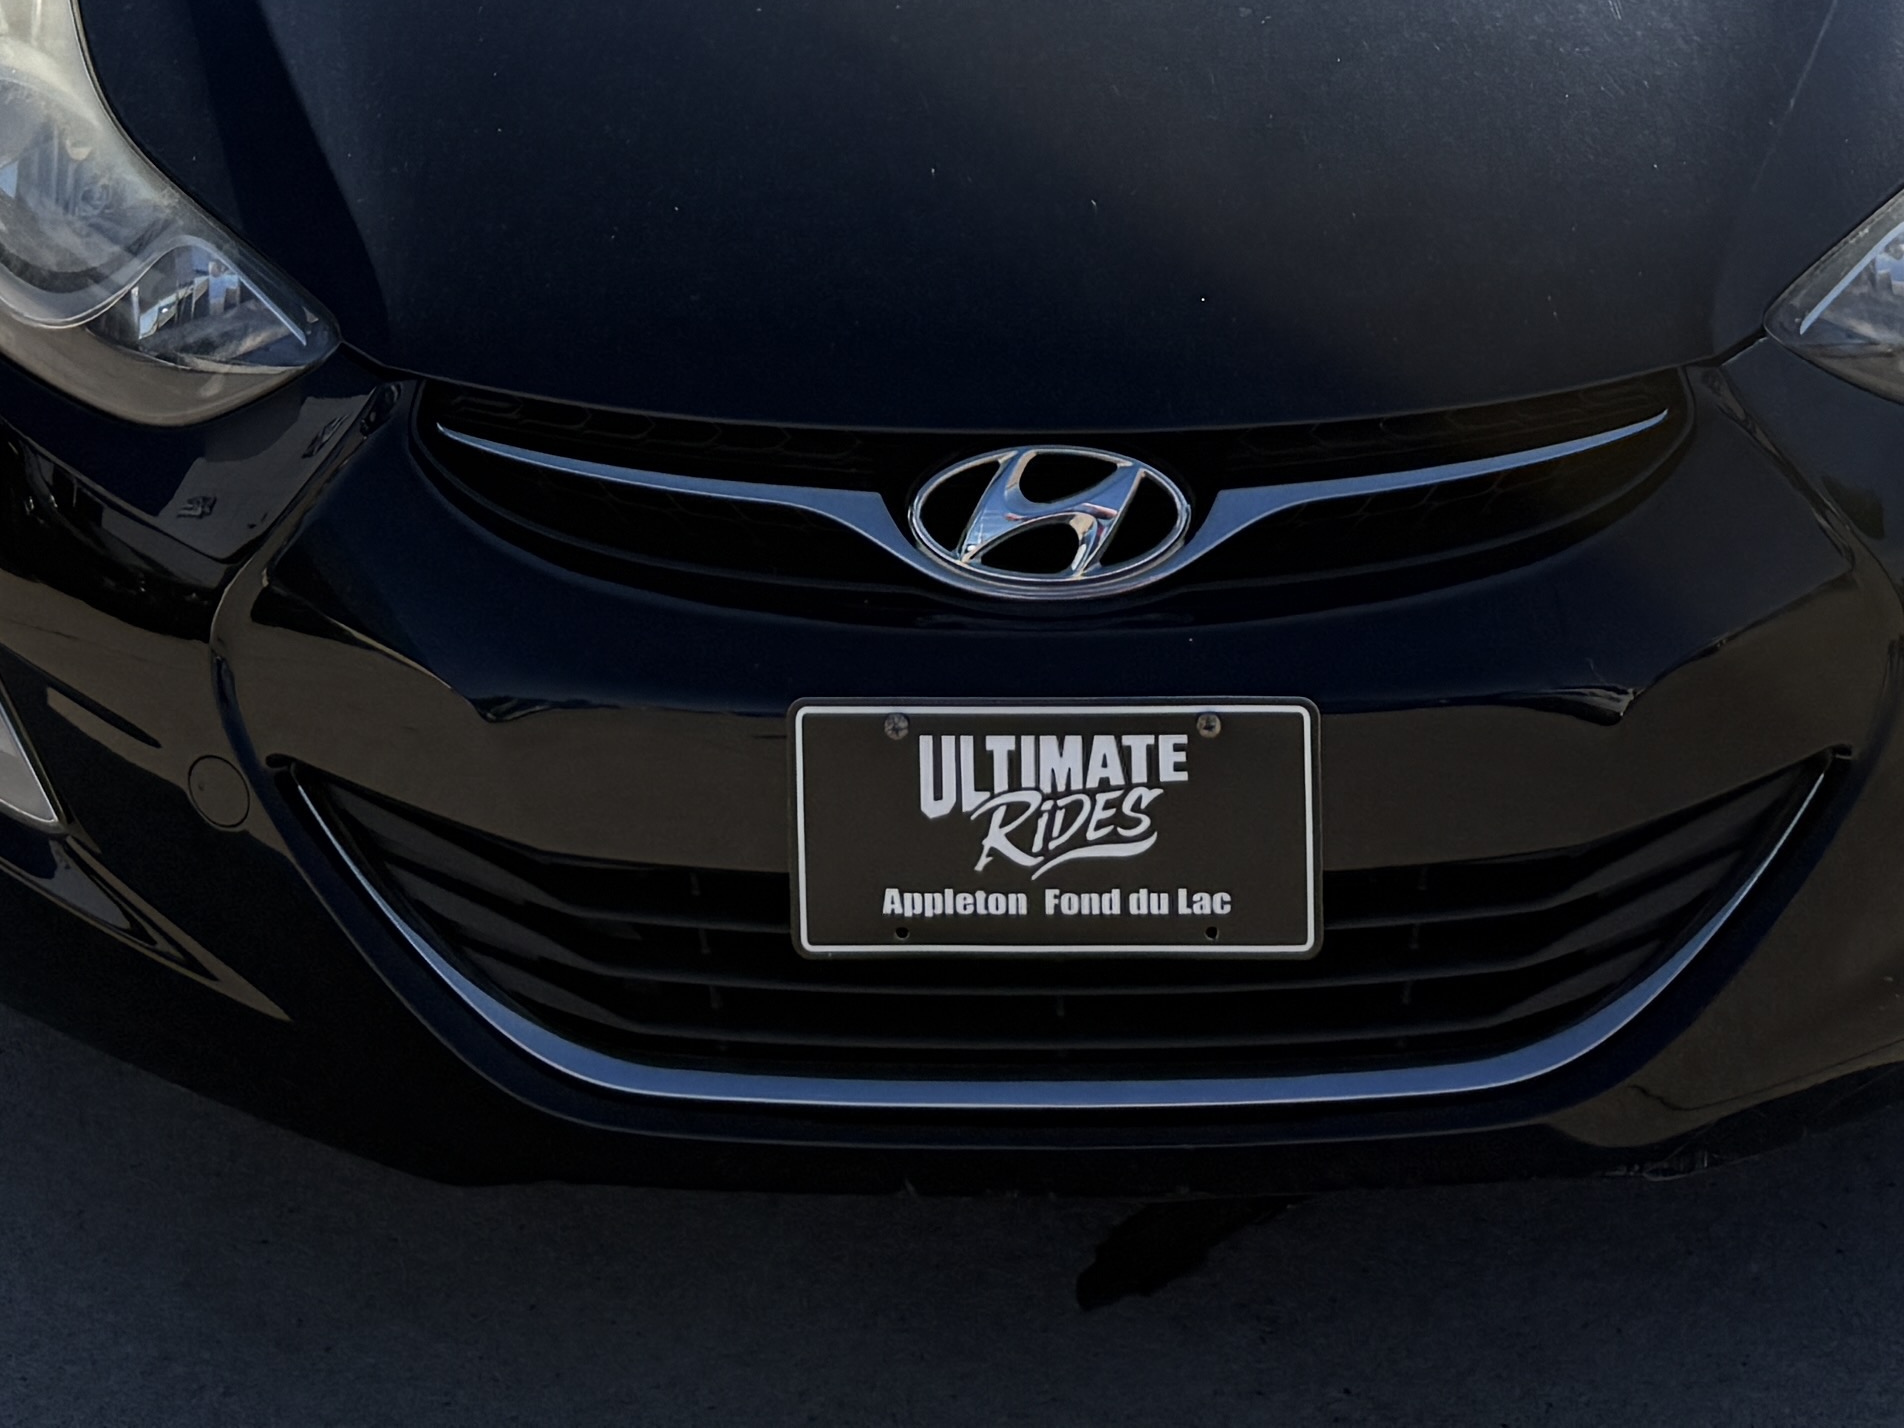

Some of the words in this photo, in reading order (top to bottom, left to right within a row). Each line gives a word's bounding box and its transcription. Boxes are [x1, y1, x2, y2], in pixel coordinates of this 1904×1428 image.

[919, 735, 1189, 819] ULTIMATE
[883, 888, 1028, 918] Appleton
[1045, 888, 1121, 916] Fond
[1129, 888, 1170, 916] du
[1178, 888, 1232, 916] Lac
